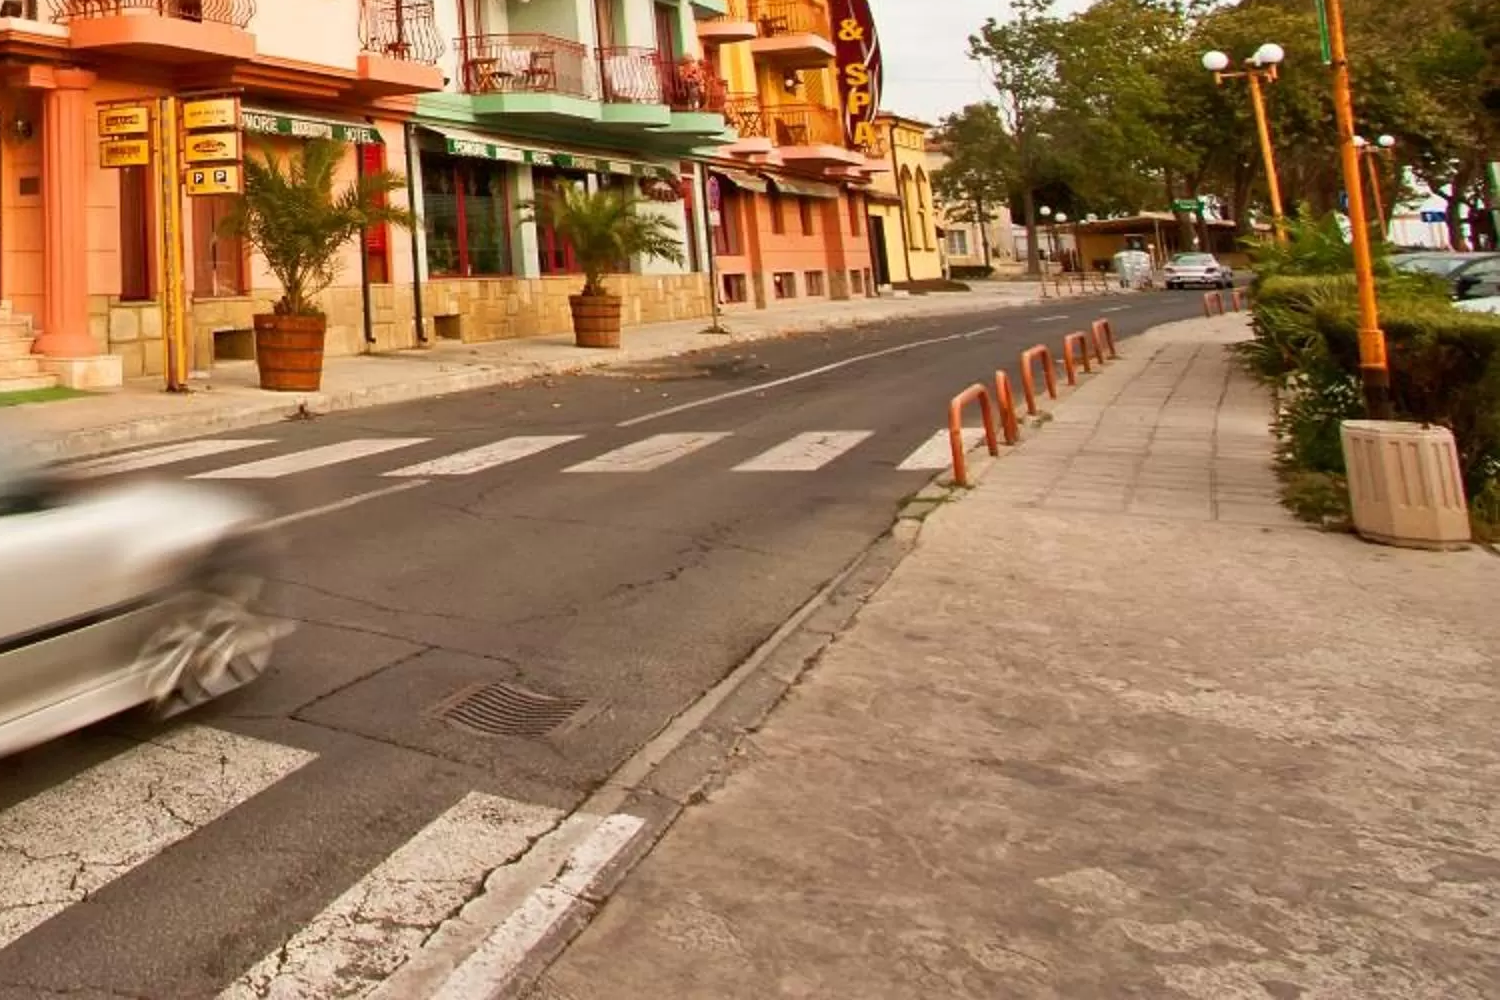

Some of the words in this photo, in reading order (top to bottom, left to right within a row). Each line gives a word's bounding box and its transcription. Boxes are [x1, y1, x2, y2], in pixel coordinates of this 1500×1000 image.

[837, 18, 864, 42] &
[844, 62, 877, 146] SPA
[343, 126, 374, 145] HOTEL
